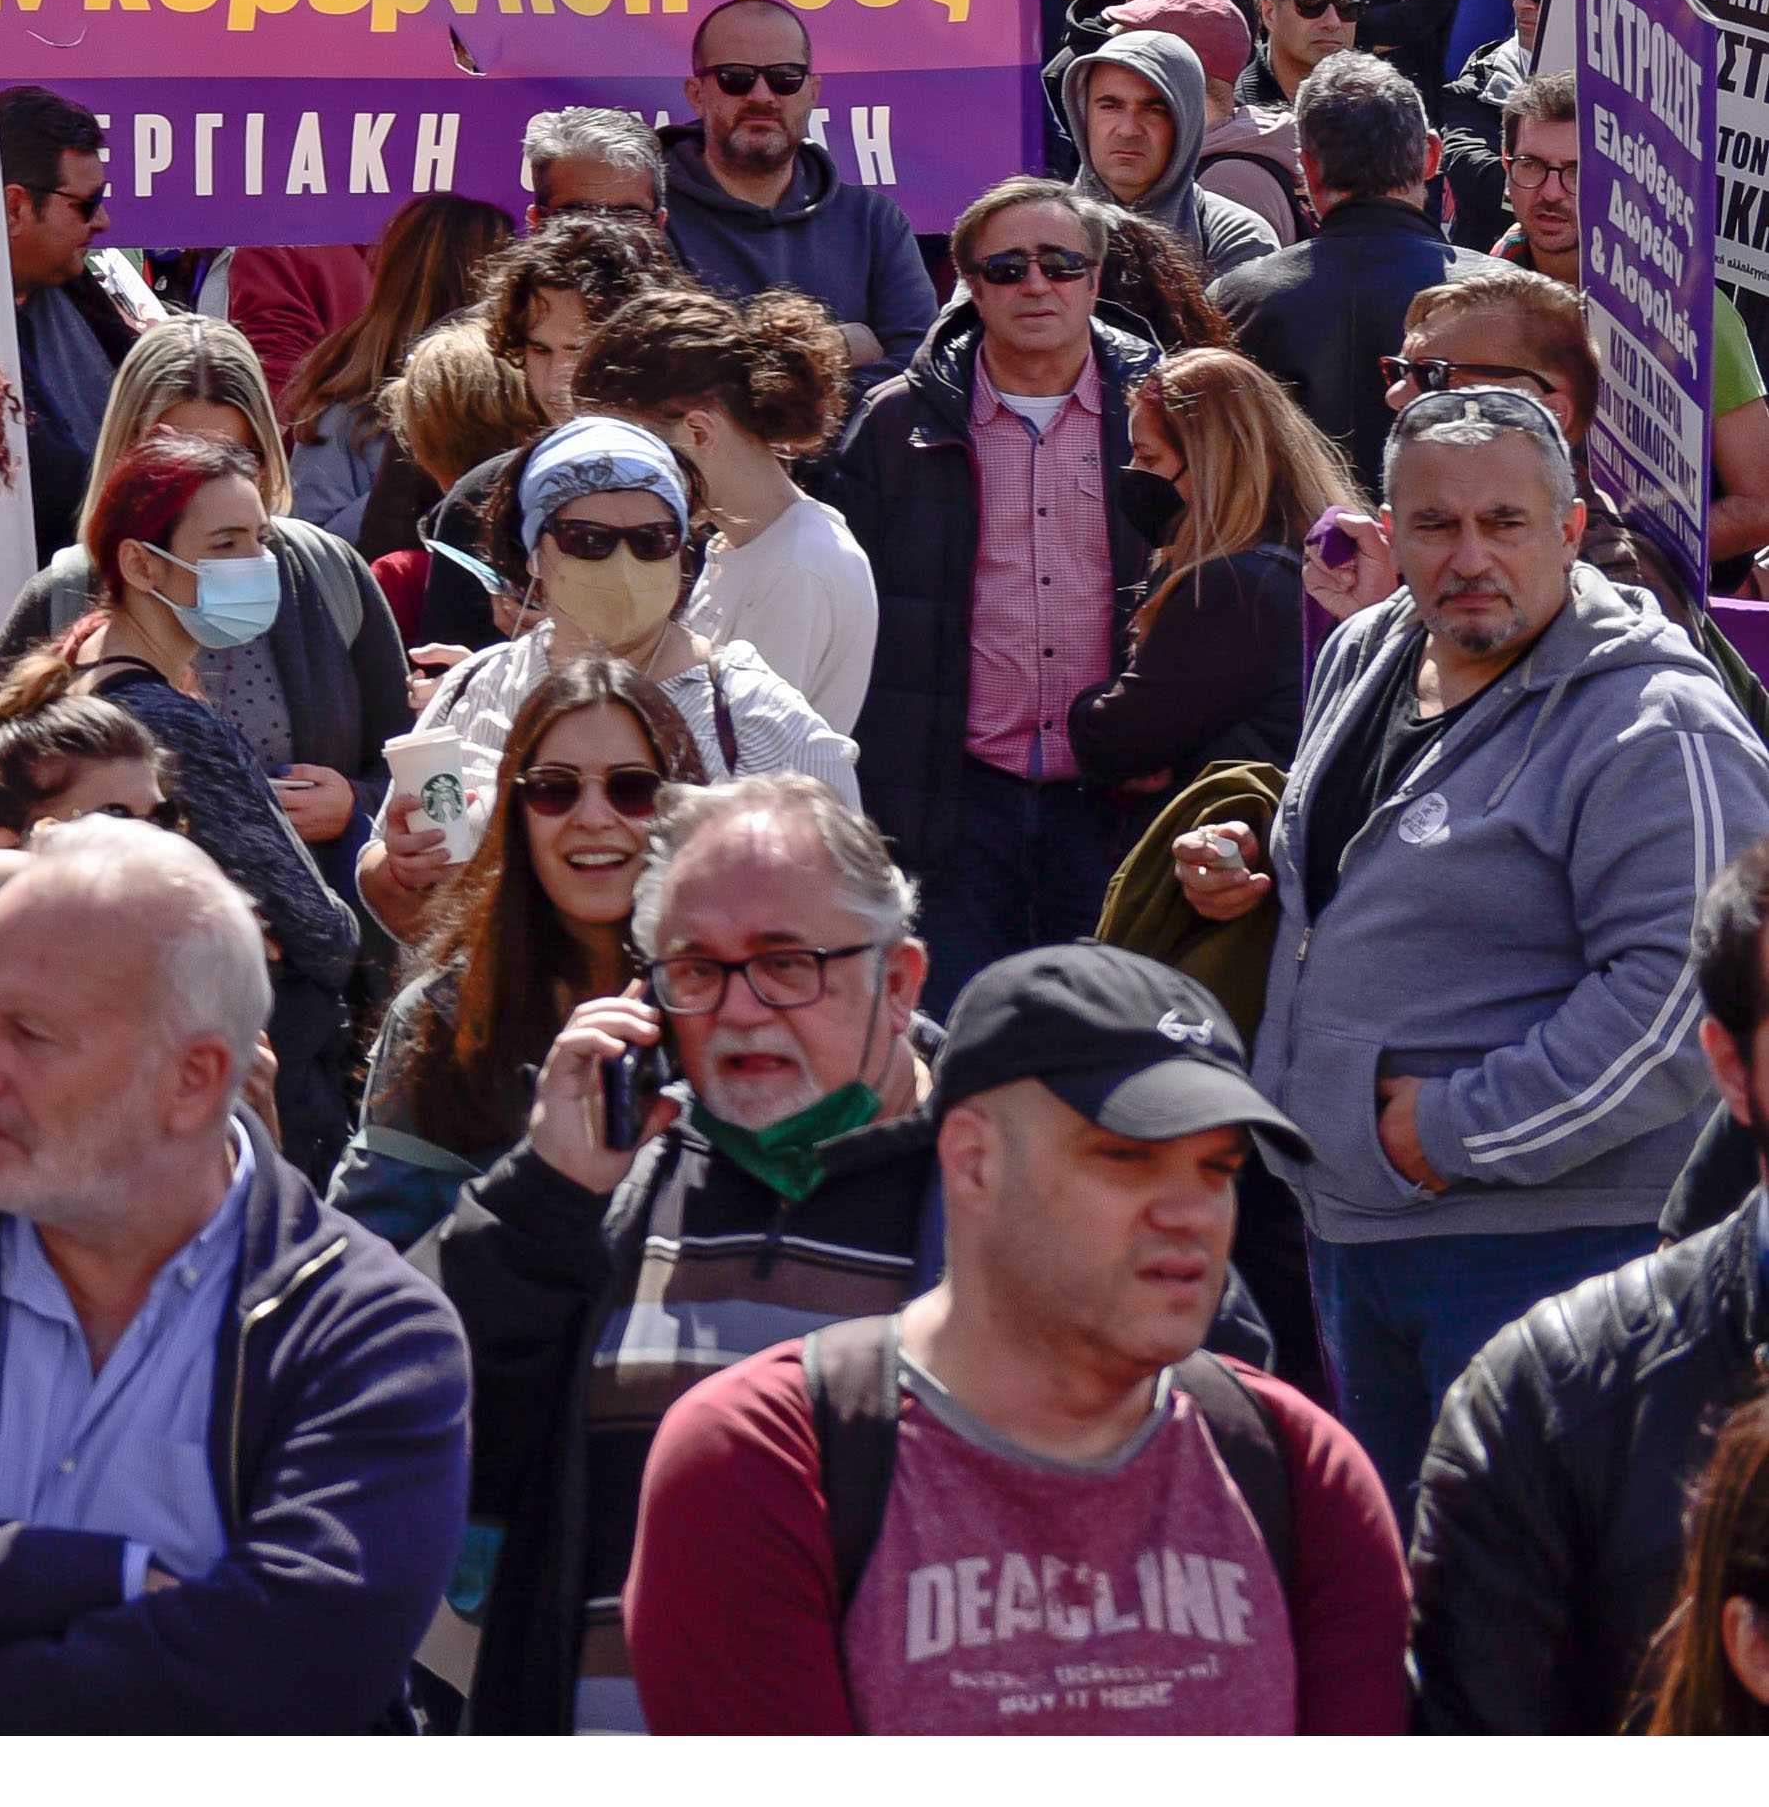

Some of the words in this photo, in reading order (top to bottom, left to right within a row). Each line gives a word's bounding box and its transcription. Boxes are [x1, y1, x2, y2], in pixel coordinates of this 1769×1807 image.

[1593, 103, 1695, 247] Ελεύθερες
[1607, 179, 1685, 290] Δωρεάν
[1590, 242, 1607, 276] &
[1610, 256, 1699, 381] Ασφαλείς
[1609, 325, 1638, 392] ΚΑΤΩ
[1626, 398, 1677, 484] ΕΠΙΛΟΓΕΣ
